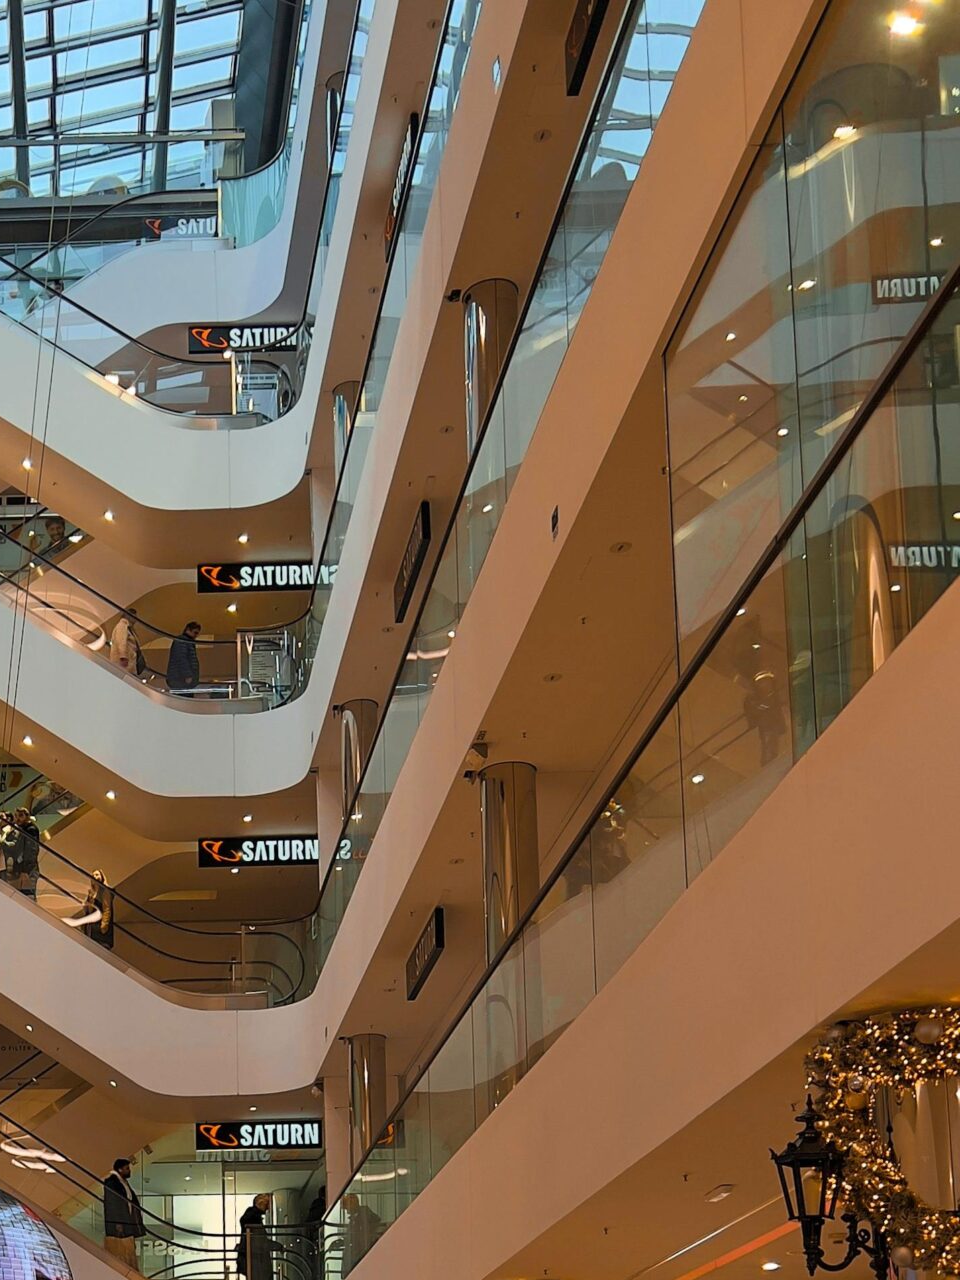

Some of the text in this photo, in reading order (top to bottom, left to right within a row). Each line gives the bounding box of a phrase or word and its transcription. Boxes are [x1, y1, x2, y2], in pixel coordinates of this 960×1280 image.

[177, 217, 216, 235] SATU
[229, 327, 297, 347] SATURN
[240, 565, 313, 587] SATURN
[241, 839, 319, 862] SATURN
[240, 1123, 319, 1146] SATURN
